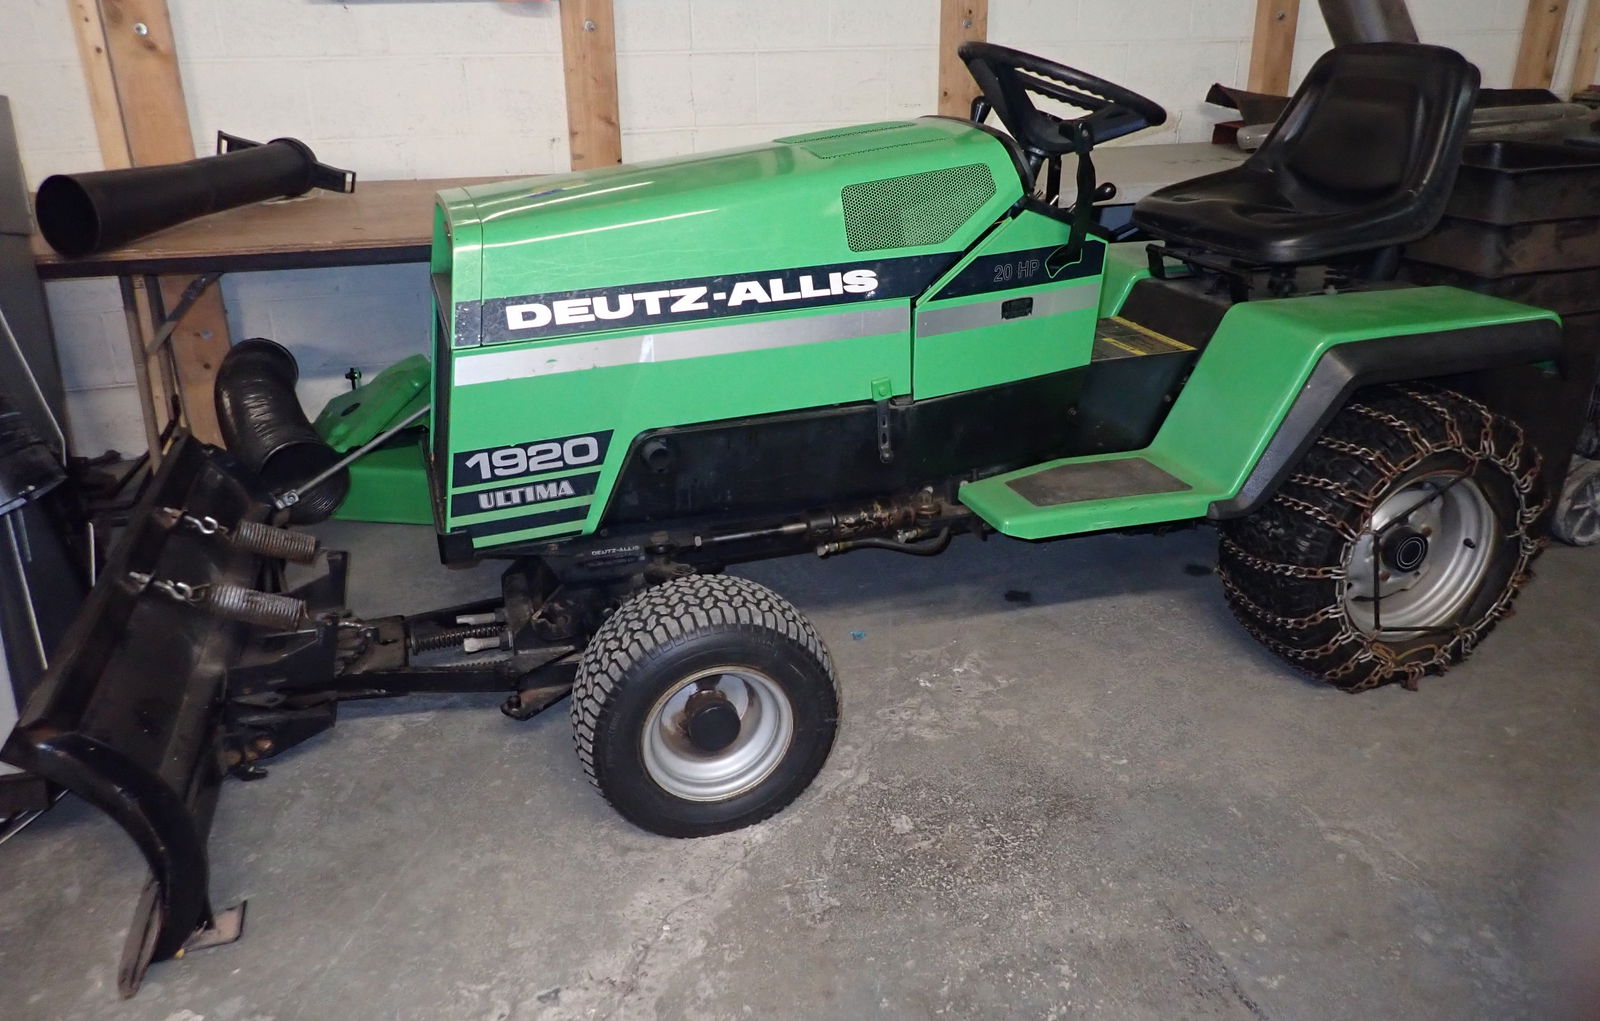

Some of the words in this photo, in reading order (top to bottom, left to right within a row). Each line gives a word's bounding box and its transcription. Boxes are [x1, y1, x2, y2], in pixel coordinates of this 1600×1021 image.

[993, 263, 1013, 282] 20
[1017, 259, 1040, 278] HP
[505, 269, 879, 330] DEUTZ-ALLIS
[465, 436, 599, 480] 1920
[478, 480, 576, 510] ULTIMA
